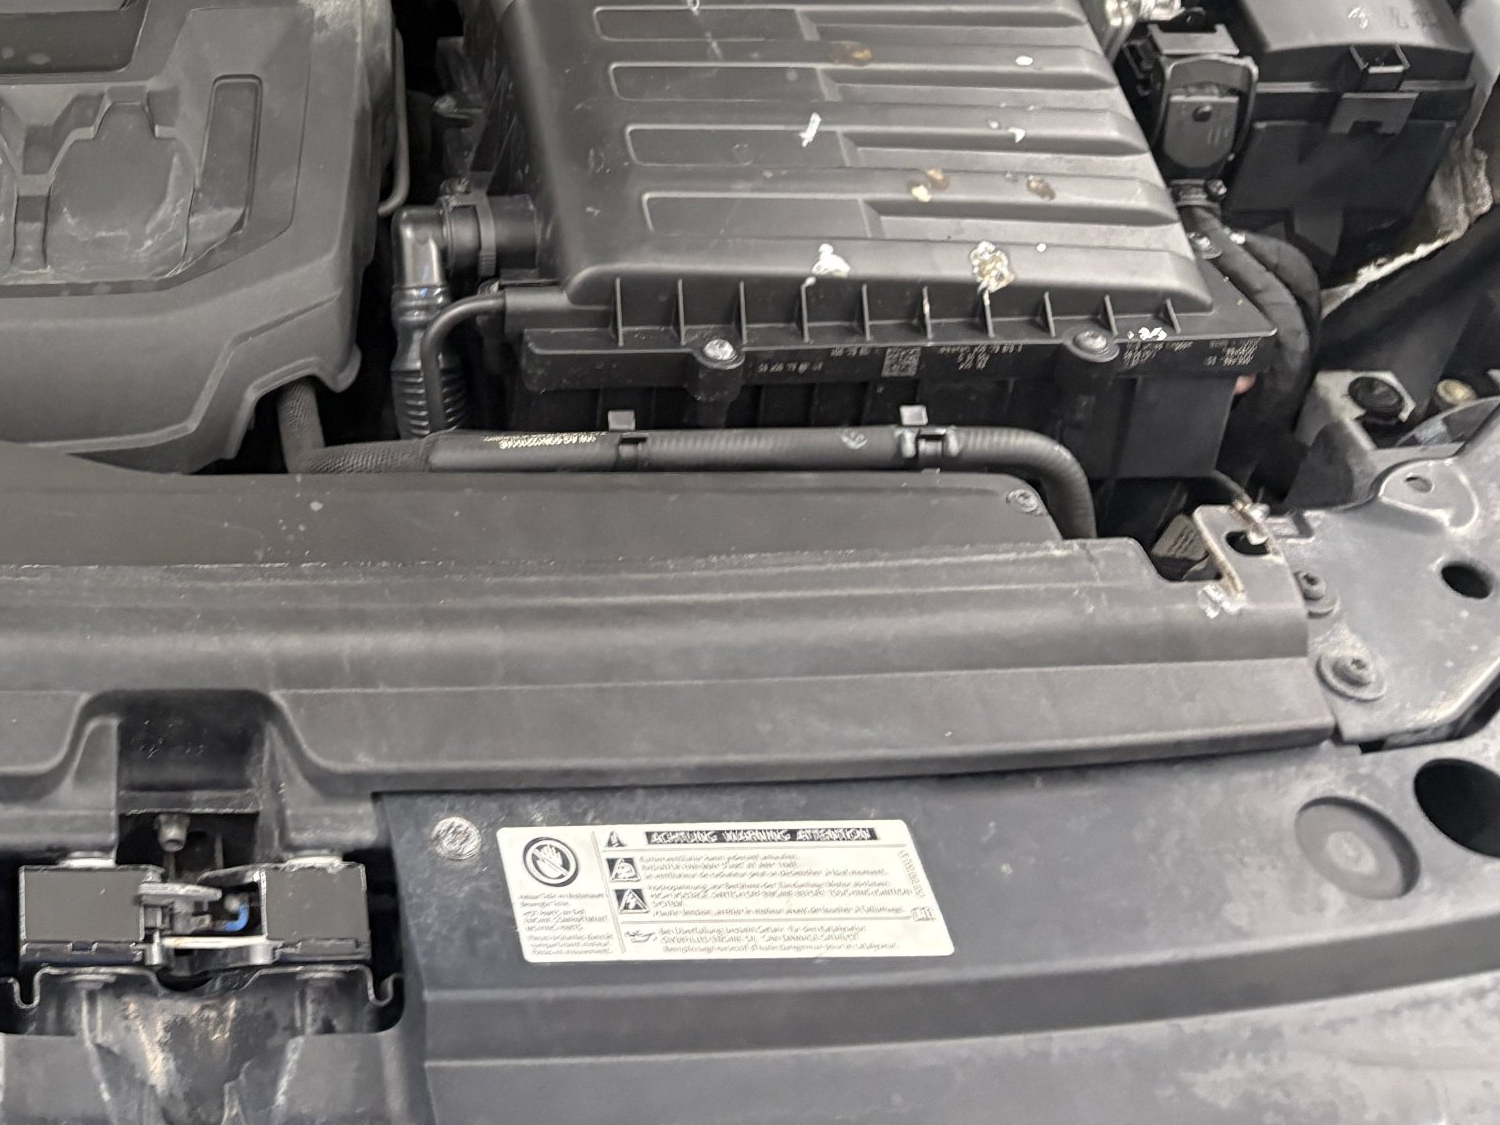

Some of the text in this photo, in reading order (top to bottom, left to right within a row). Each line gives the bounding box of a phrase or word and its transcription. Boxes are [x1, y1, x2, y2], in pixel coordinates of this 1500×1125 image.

[650, 828, 872, 844] ACHTUNG WARNING ATTENTION
